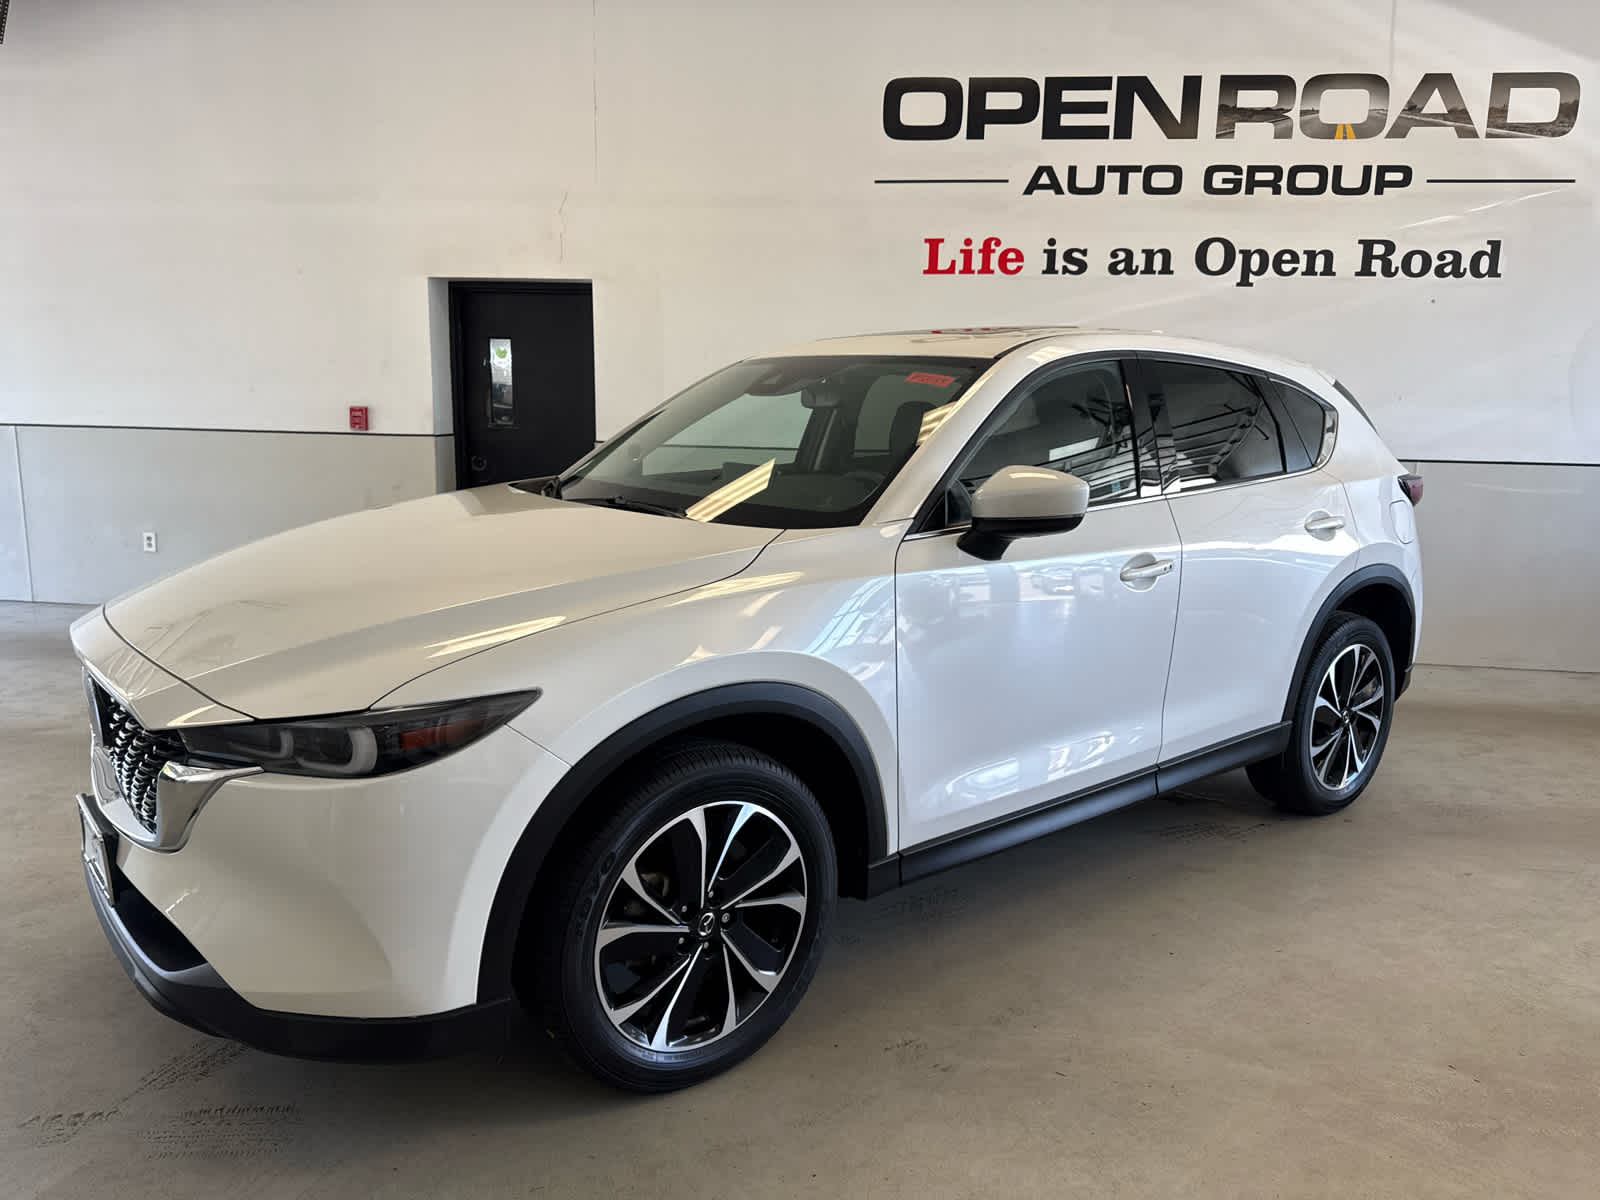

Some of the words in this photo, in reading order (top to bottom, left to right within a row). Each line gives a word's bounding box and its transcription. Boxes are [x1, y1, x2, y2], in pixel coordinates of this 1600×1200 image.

[882, 75, 1202, 141] OPEN
[1216, 72, 1580, 140] ROAD
[1022, 164, 1183, 196] AUTO
[1203, 164, 1413, 196] GROUP
[922, 237, 1025, 276] Life
[1041, 237, 1089, 276] is
[1107, 247, 1175, 276] an
[1194, 236, 1337, 288] Open
[1354, 239, 1503, 279] Road
